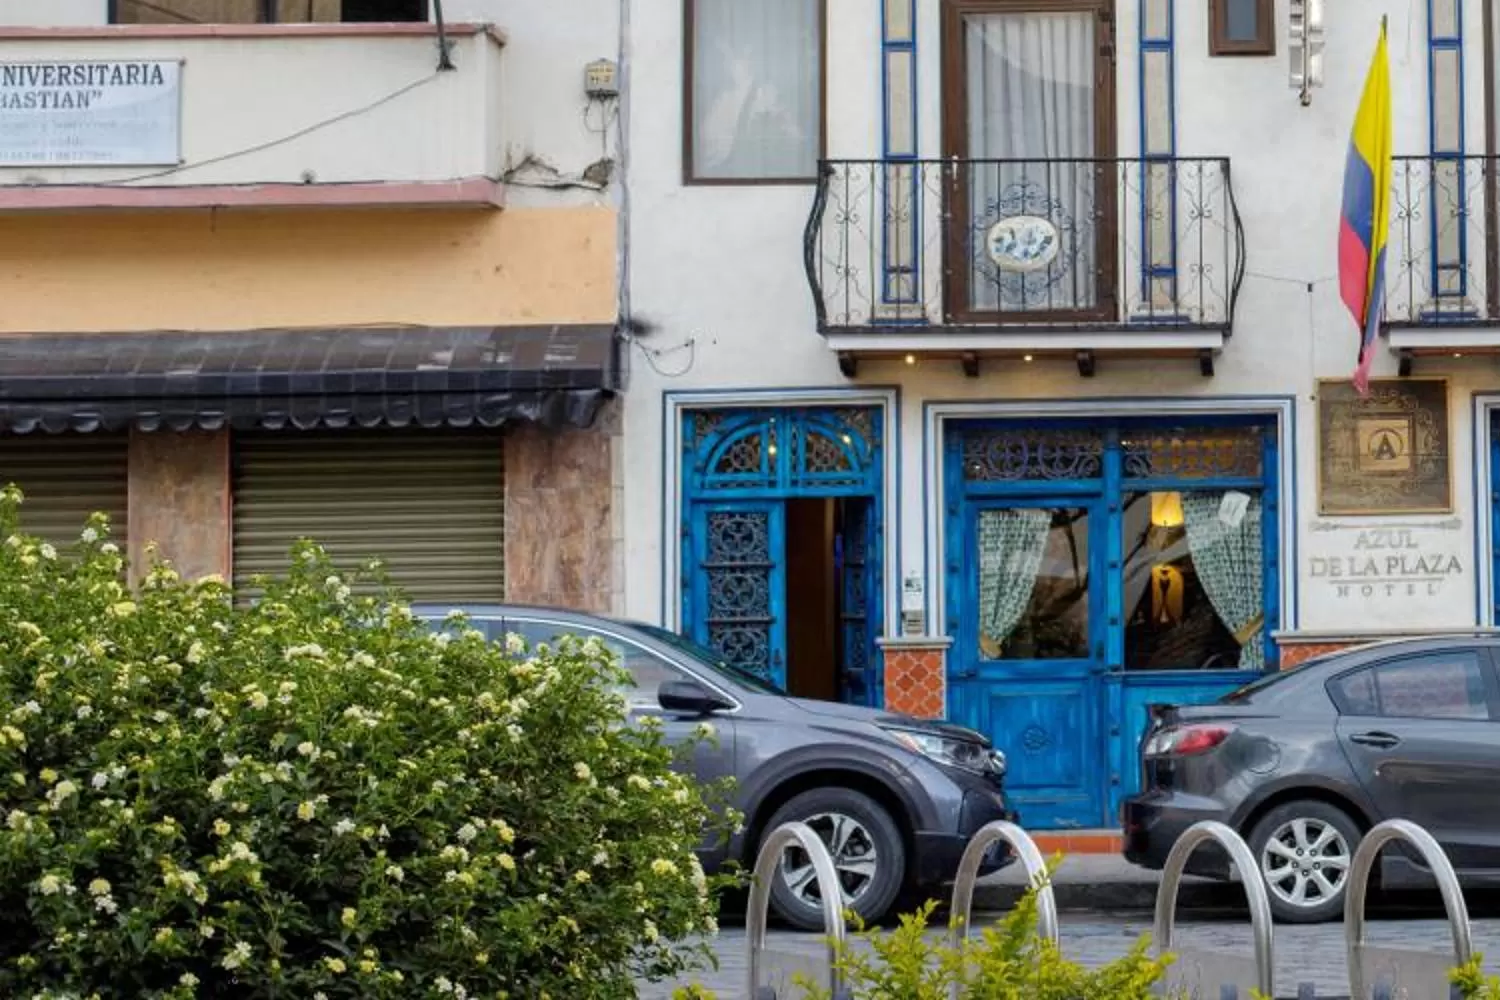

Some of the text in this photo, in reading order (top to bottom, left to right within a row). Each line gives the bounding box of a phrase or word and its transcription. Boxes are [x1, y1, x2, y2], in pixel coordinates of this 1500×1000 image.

[0, 63, 164, 87] NIVERSITARIA
[1353, 530, 1419, 549] AZUL
[1309, 554, 1463, 577] DE LA PLAZA
[1336, 583, 1438, 597] HOTEL
